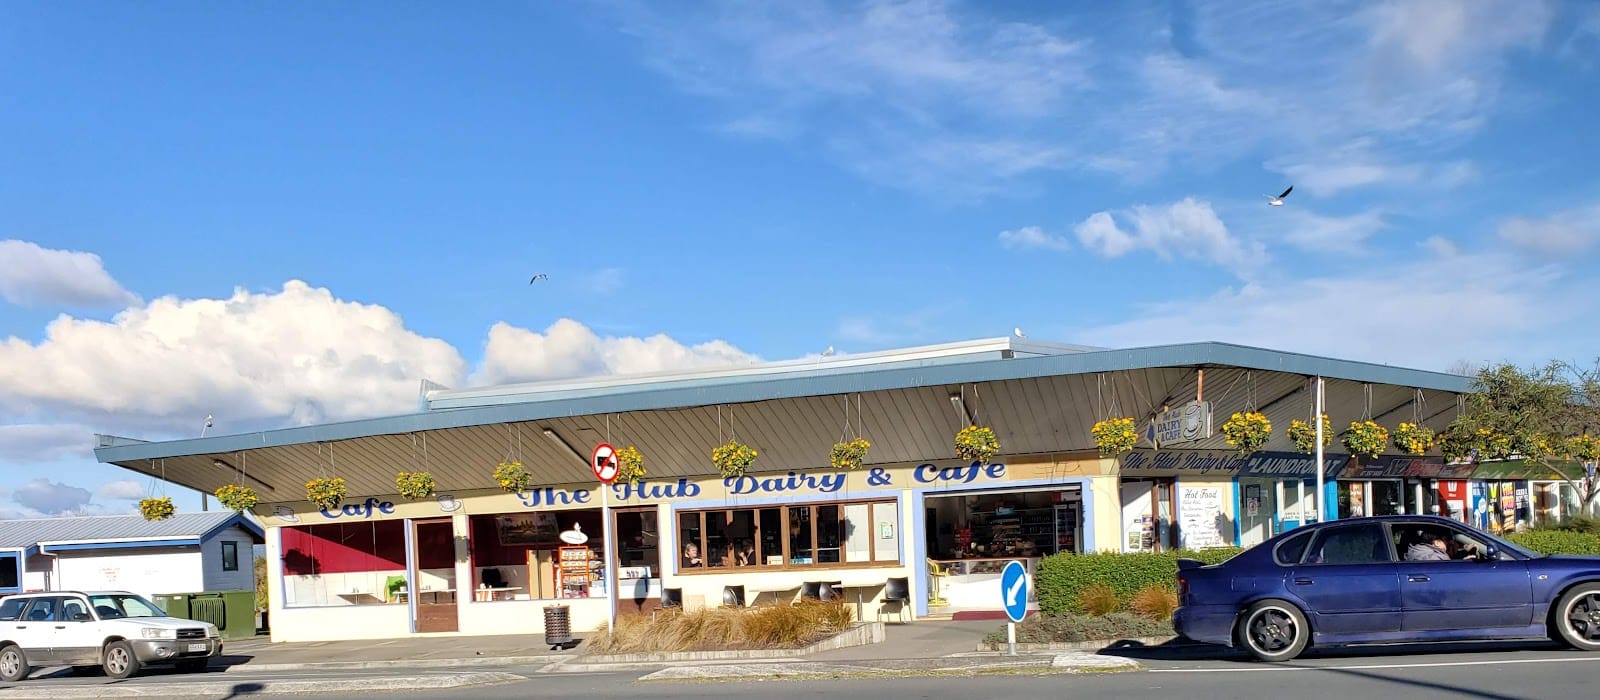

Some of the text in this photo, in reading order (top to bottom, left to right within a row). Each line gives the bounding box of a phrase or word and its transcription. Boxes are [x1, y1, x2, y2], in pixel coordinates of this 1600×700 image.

[1157, 419, 1181, 433] DAIRY
[1165, 430, 1181, 441] CAFE
[1121, 452, 1148, 470] The
[1147, 452, 1183, 470] Hub
[1178, 453, 1219, 474] Dairy
[516, 460, 1006, 507] The Hub Dairy & Cafe
[1184, 488, 1218, 499] Hot Food
